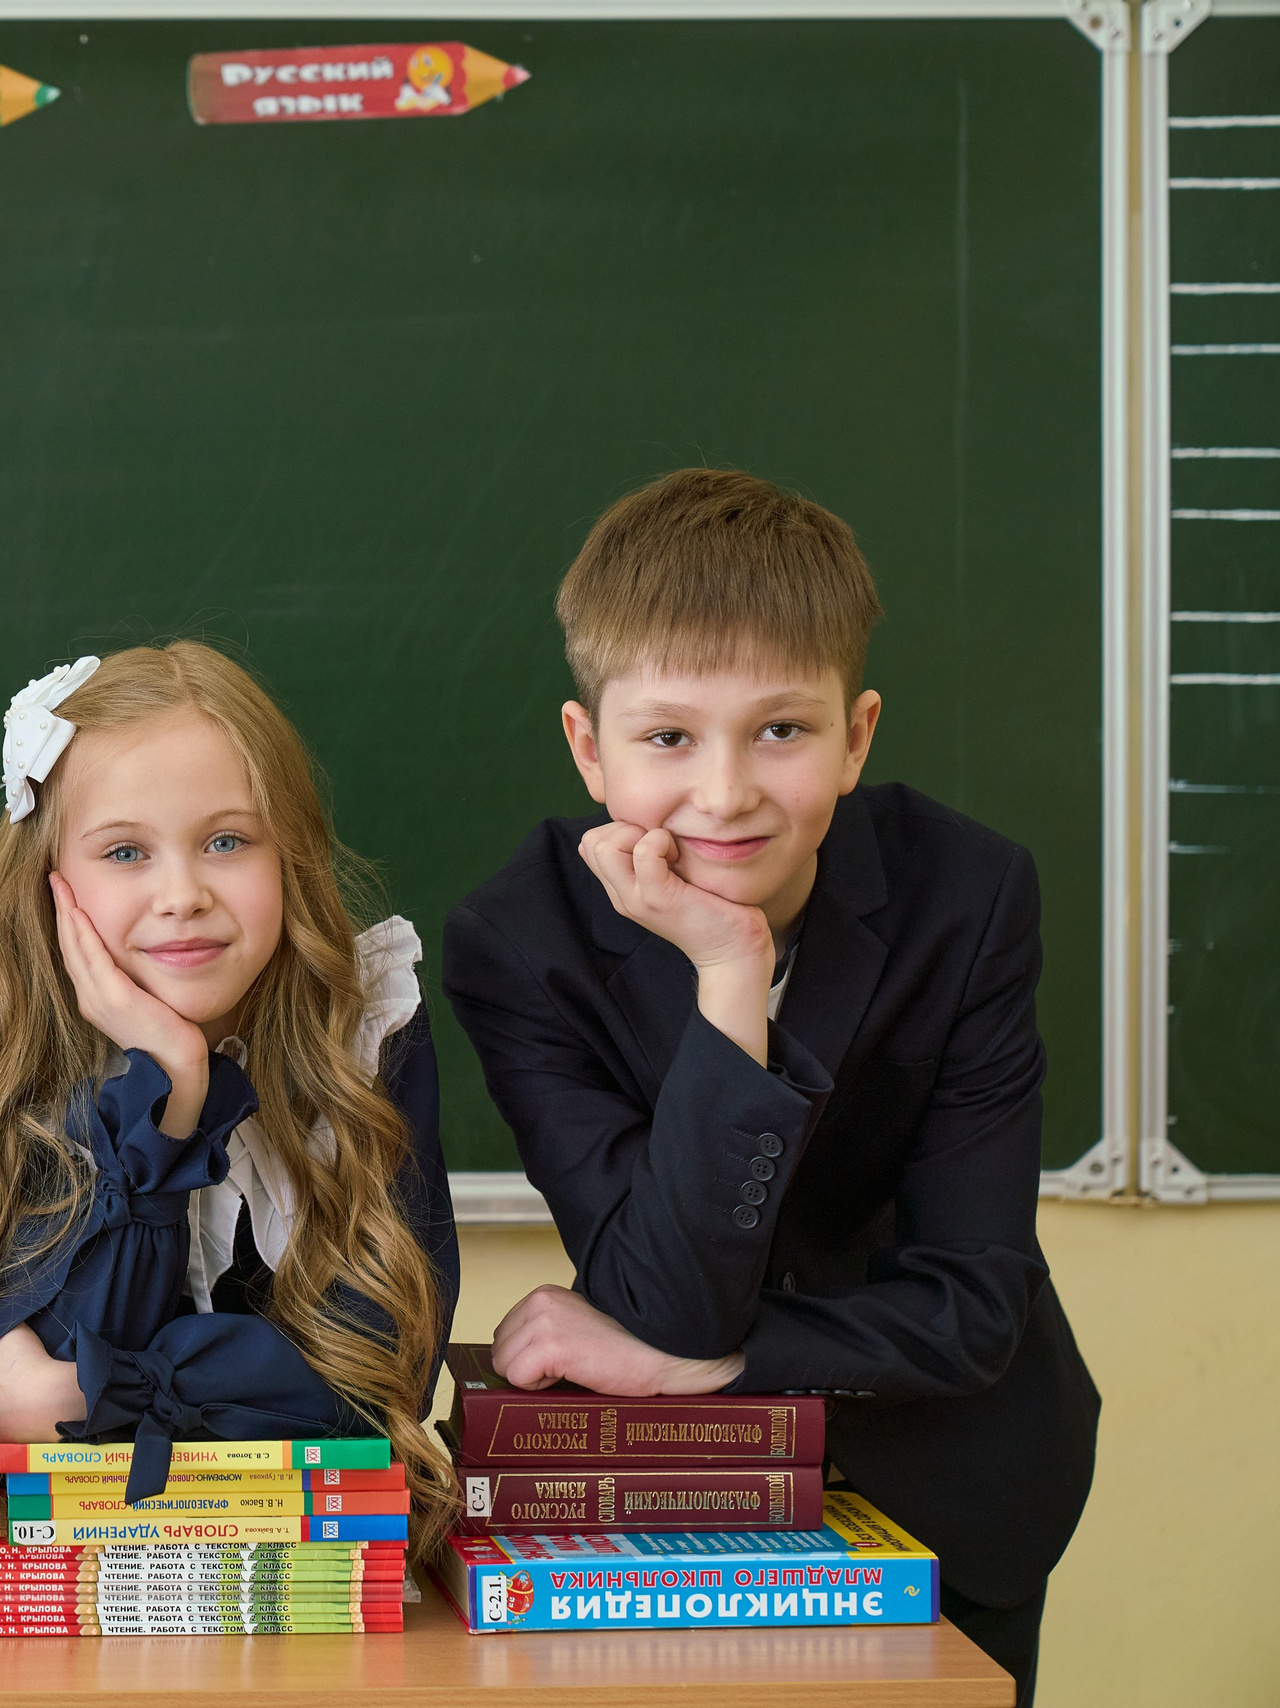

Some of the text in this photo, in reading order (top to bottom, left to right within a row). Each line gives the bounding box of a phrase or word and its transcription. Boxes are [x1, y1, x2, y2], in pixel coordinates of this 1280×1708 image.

[221, 56, 394, 87] Русский
[253, 93, 364, 117] язык
[537, 1412, 589, 1430] ЯЗЫКА
[599, 1408, 617, 1454] СЛОВАРЬ
[625, 1422, 763, 1446] ФРАЗЕОЛОГИЧЕСКИЙ
[768, 1408, 787, 1456] БОЛЬШОЙ
[513, 1433, 588, 1450] РУССКОГО
[42, 1452, 102, 1463] СЛОВАРЬ
[65, 1476, 100, 1484] СЛОВАРЬ
[535, 1482, 587, 1499] ЯЗЫКА
[597, 1476, 615, 1523] СЛОВАРЬ
[765, 1473, 785, 1523] БОЛЬШОЙ
[79, 1500, 128, 1510] СЛОВАРЬ
[132, 1499, 229, 1512] ФРАЗЕОЛОГИЧЕСКИЙ
[240, 1499, 264, 1508] Баско
[511, 1503, 586, 1520] РУССКОГО
[623, 1491, 761, 1515] ФРАЗЕОЛОГИЧЕСКИЙ
[73, 1523, 160, 1540] УДАРЕНИЙ
[163, 1524, 239, 1538] СЛОВАРЬ
[550, 1565, 883, 1589] МЛАДШЕГО ШКОЛЬНИКА
[551, 1588, 883, 1620] ЭНЦИКЛОПЕДИЯ
